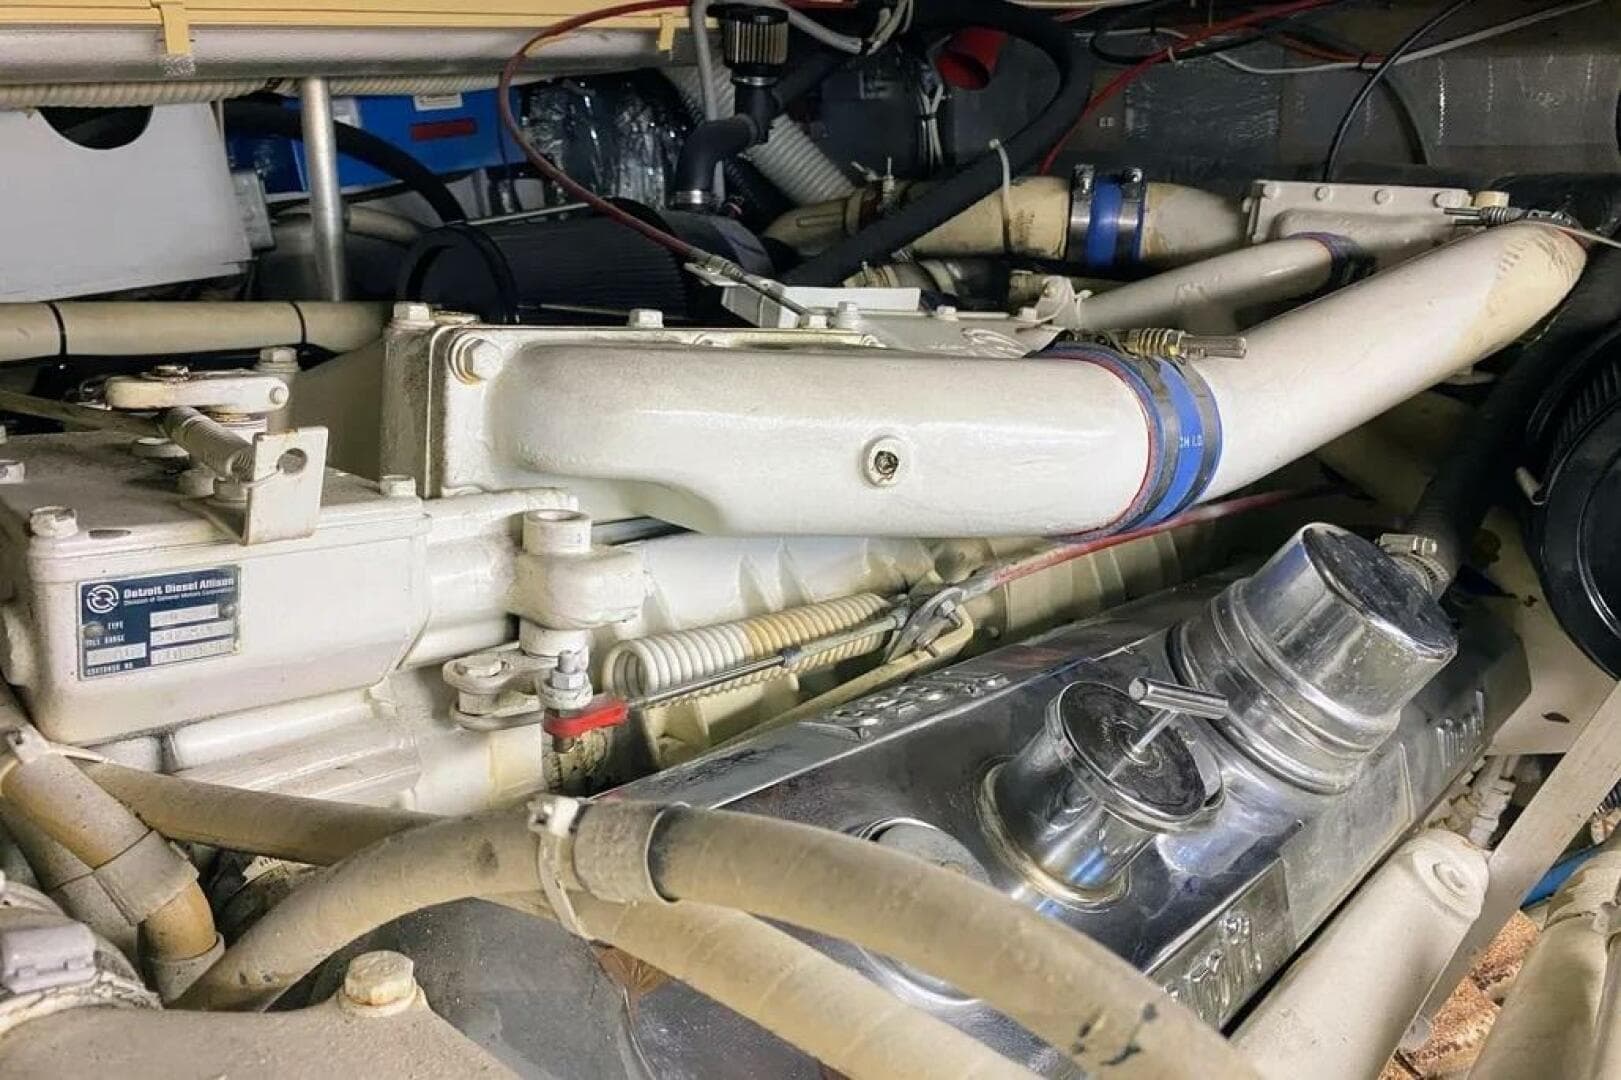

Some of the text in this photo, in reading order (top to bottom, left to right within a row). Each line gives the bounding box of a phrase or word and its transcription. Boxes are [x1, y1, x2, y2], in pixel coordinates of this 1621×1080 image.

[123, 578, 235, 599] Detroit Diesel Allison
